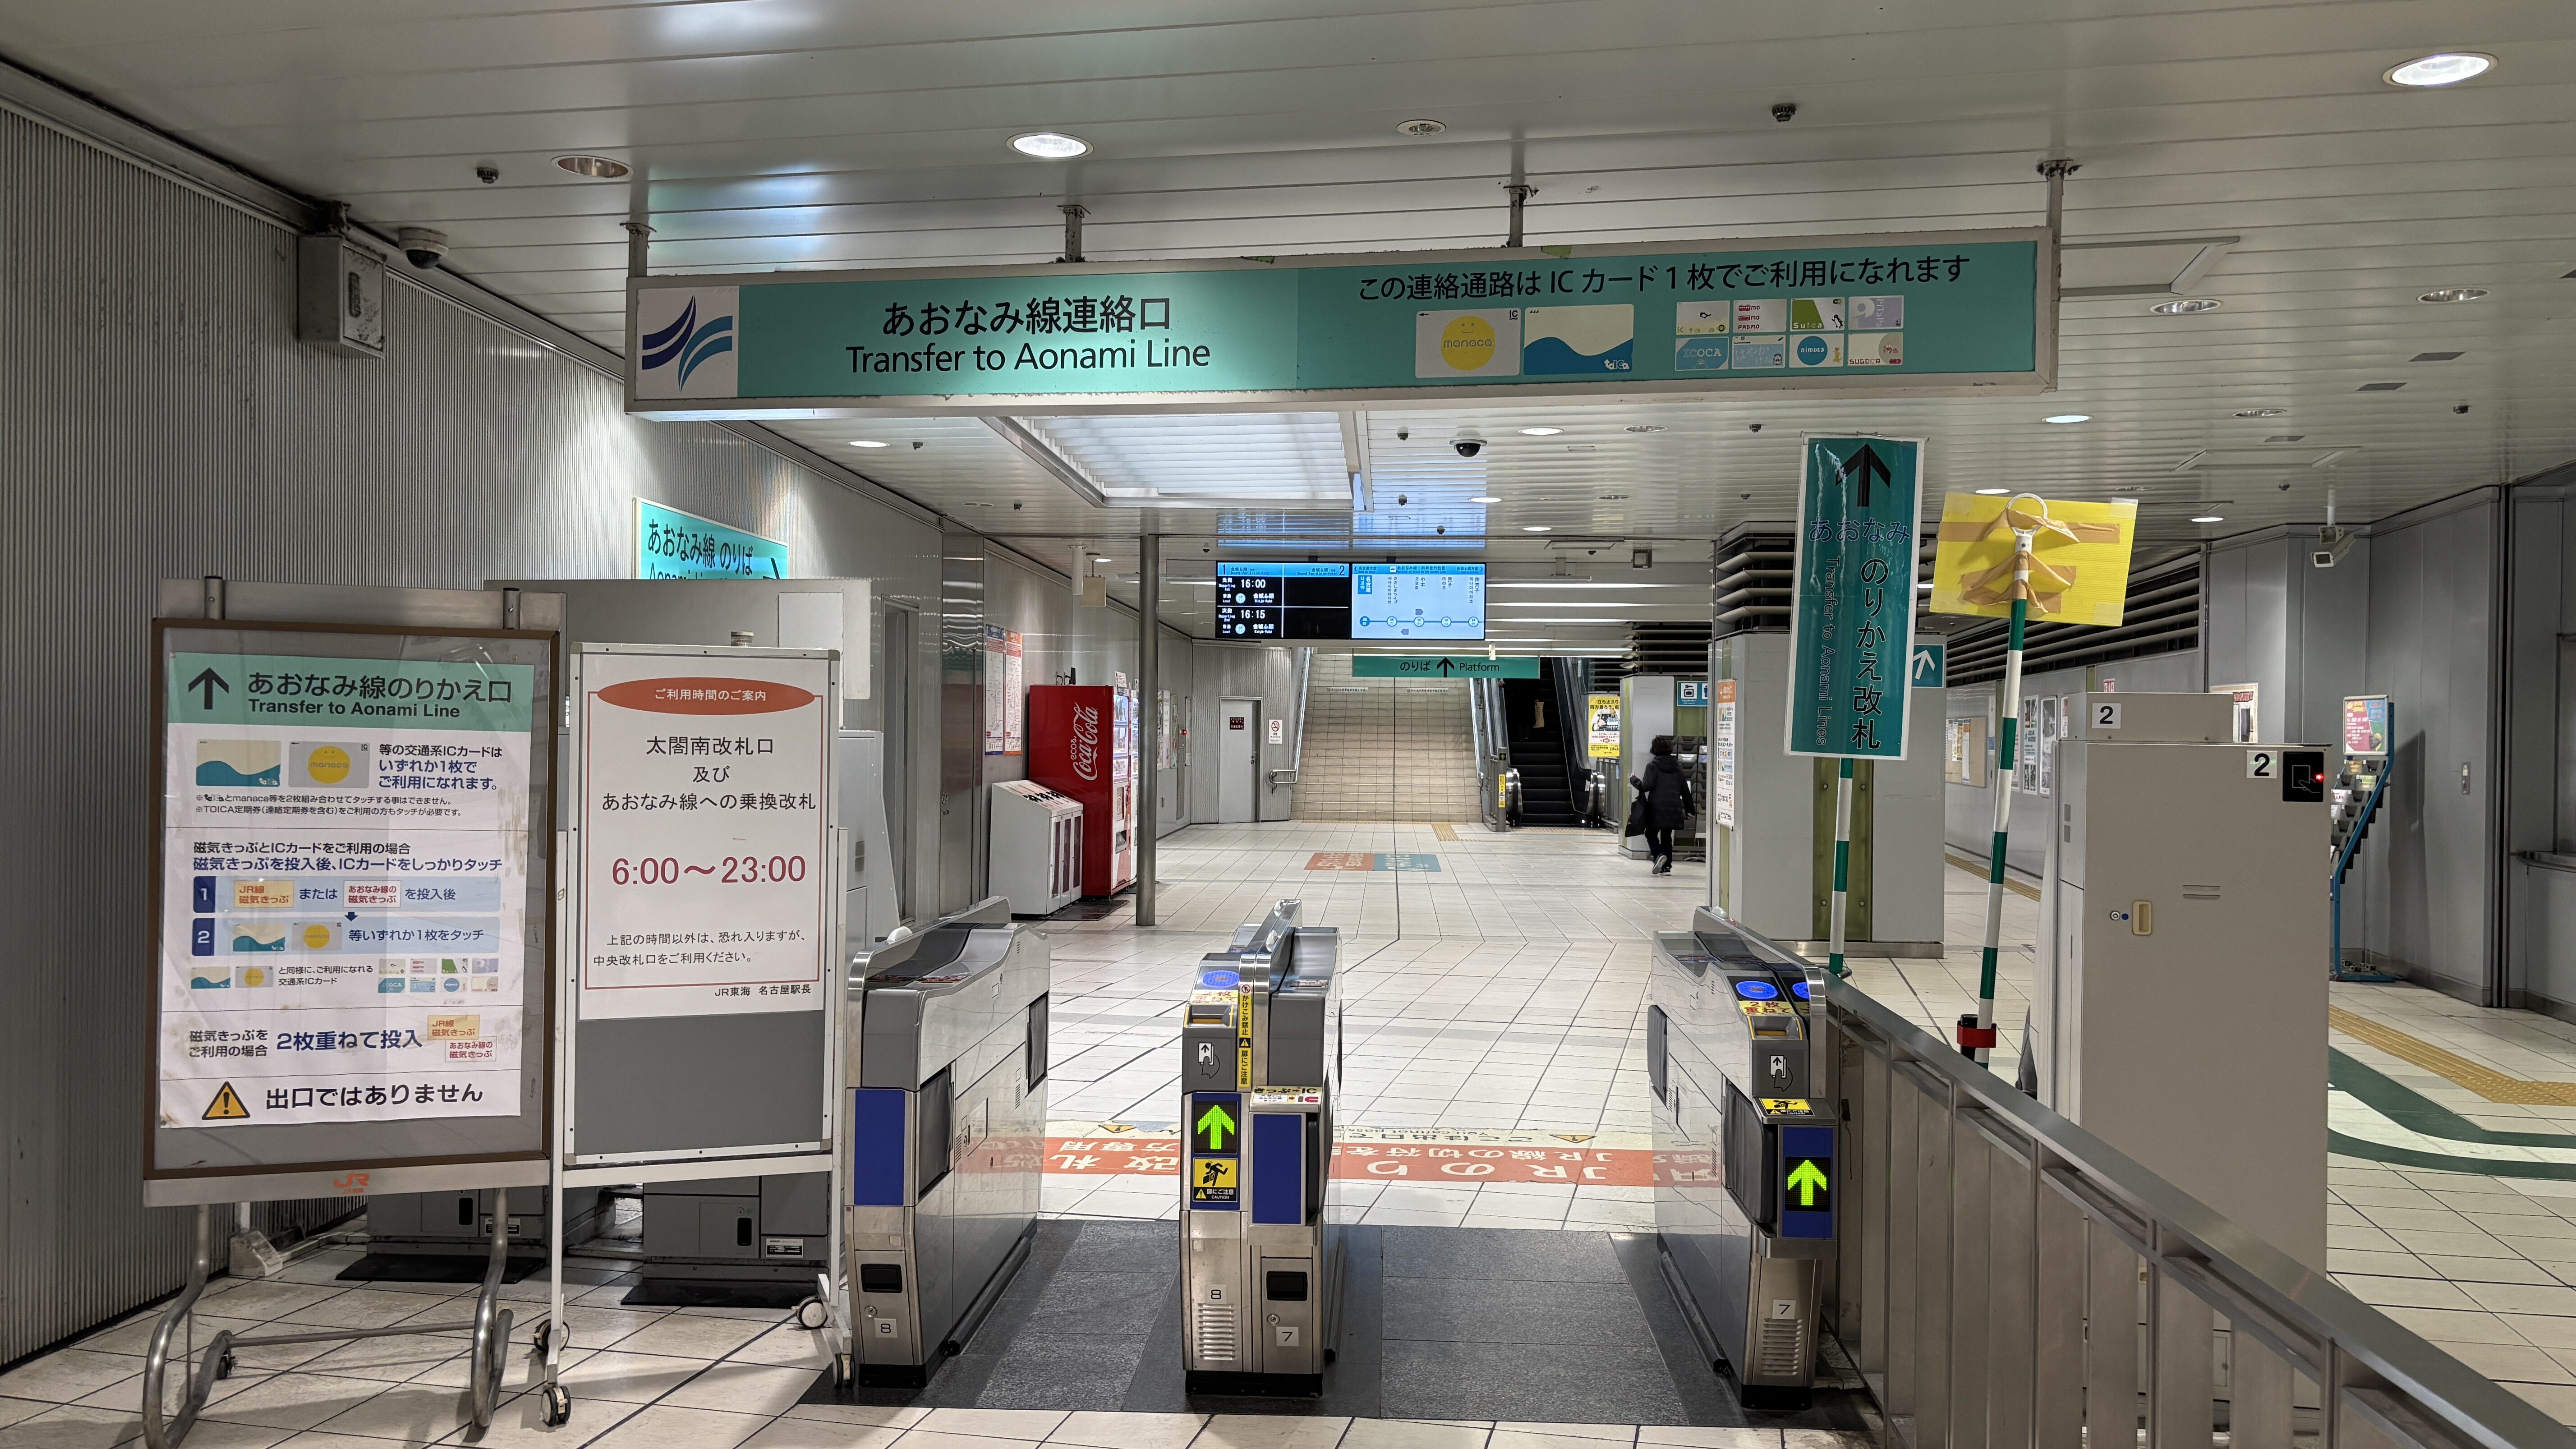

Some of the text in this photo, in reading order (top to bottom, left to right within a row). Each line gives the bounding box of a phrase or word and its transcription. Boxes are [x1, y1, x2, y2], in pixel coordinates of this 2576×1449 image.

[883, 293, 1173, 336] あおなみ線連絡口
[1443, 339, 1492, 348] manaca
[846, 337, 1211, 374] Transfer to Aonami Line
[1809, 517, 1910, 544] あおなみ
[648, 518, 716, 569] あおなみ線
[720, 542, 754, 576] のりば
[1339, 565, 1345, 576] 2
[1241, 579, 1266, 589] 16:00
[1241, 609, 1266, 619] 16:15
[1816, 555, 1841, 745] Transfer to Aonami Lines
[1851, 558, 1889, 750] のりかえ改札
[1400, 661, 1431, 672] のりば
[1459, 662, 1500, 672] Platform
[247, 672, 512, 704] あおなみ線のりかえ口
[654, 687, 767, 702] ご利用時間のご案内
[248, 699, 461, 718] Transfer to Aonami Line
[2099, 705, 2113, 724] 2
[646, 735, 775, 756] 太閤南改札口
[1072, 701, 1099, 781] Coca-Cola
[379, 743, 503, 758] 等の交通系ICカードは
[379, 759, 478, 774] いずれか1枚で
[2254, 753, 2270, 777] 2
[692, 766, 730, 783] 及び
[379, 775, 497, 791] ご利用になれます。
[602, 792, 817, 811] あおなみ線への乗換改札
[193, 841, 411, 855] 磁気きっぷとICカードをご利用の場合
[193, 857, 502, 871] 磁気きっぷを投入後、ICカードをしっかりタッチ
[201, 888, 207, 901] 1
[299, 888, 338, 900] または
[348, 885, 397, 893] あおなみ線の
[405, 888, 456, 901] を投入後
[239, 894, 289, 905] 磁気きっぷ
[348, 895, 397, 904] 磁気きっぷ
[197, 930, 210, 944] 2
[349, 929, 484, 941] 等いずれか1枚をタッチ
[606, 930, 806, 947] 上記の時間以外は、恐れ入りますが、
[593, 951, 753, 966] 中央改札口をご利用ください。
[278, 965, 373, 975] と同様に、ご利用になれる
[278, 978, 338, 987] 交通系ICカード
[714, 984, 812, 998] JR東海 名古屋駅長
[189, 1029, 268, 1043] 磁気きっぷを
[432, 1028, 475, 1037] 磁気きっぷ
[276, 1029, 423, 1051] 2枚重ねて投入
[449, 1041, 493, 1049] あおなみ線の
[189, 1044, 268, 1058] ご利用の場合
[449, 1050, 492, 1058] 磁気きっぷ
[1240, 1050, 1248, 1085] 扉にご注意
[266, 1083, 483, 1109] 出口ではありません
[333, 1173, 369, 1188] JR
[1210, 1289, 1221, 1300] 8
[1779, 1303, 1791, 1315] 7
[880, 1322, 891, 1334] 8
[1282, 1331, 1293, 1342] 7
